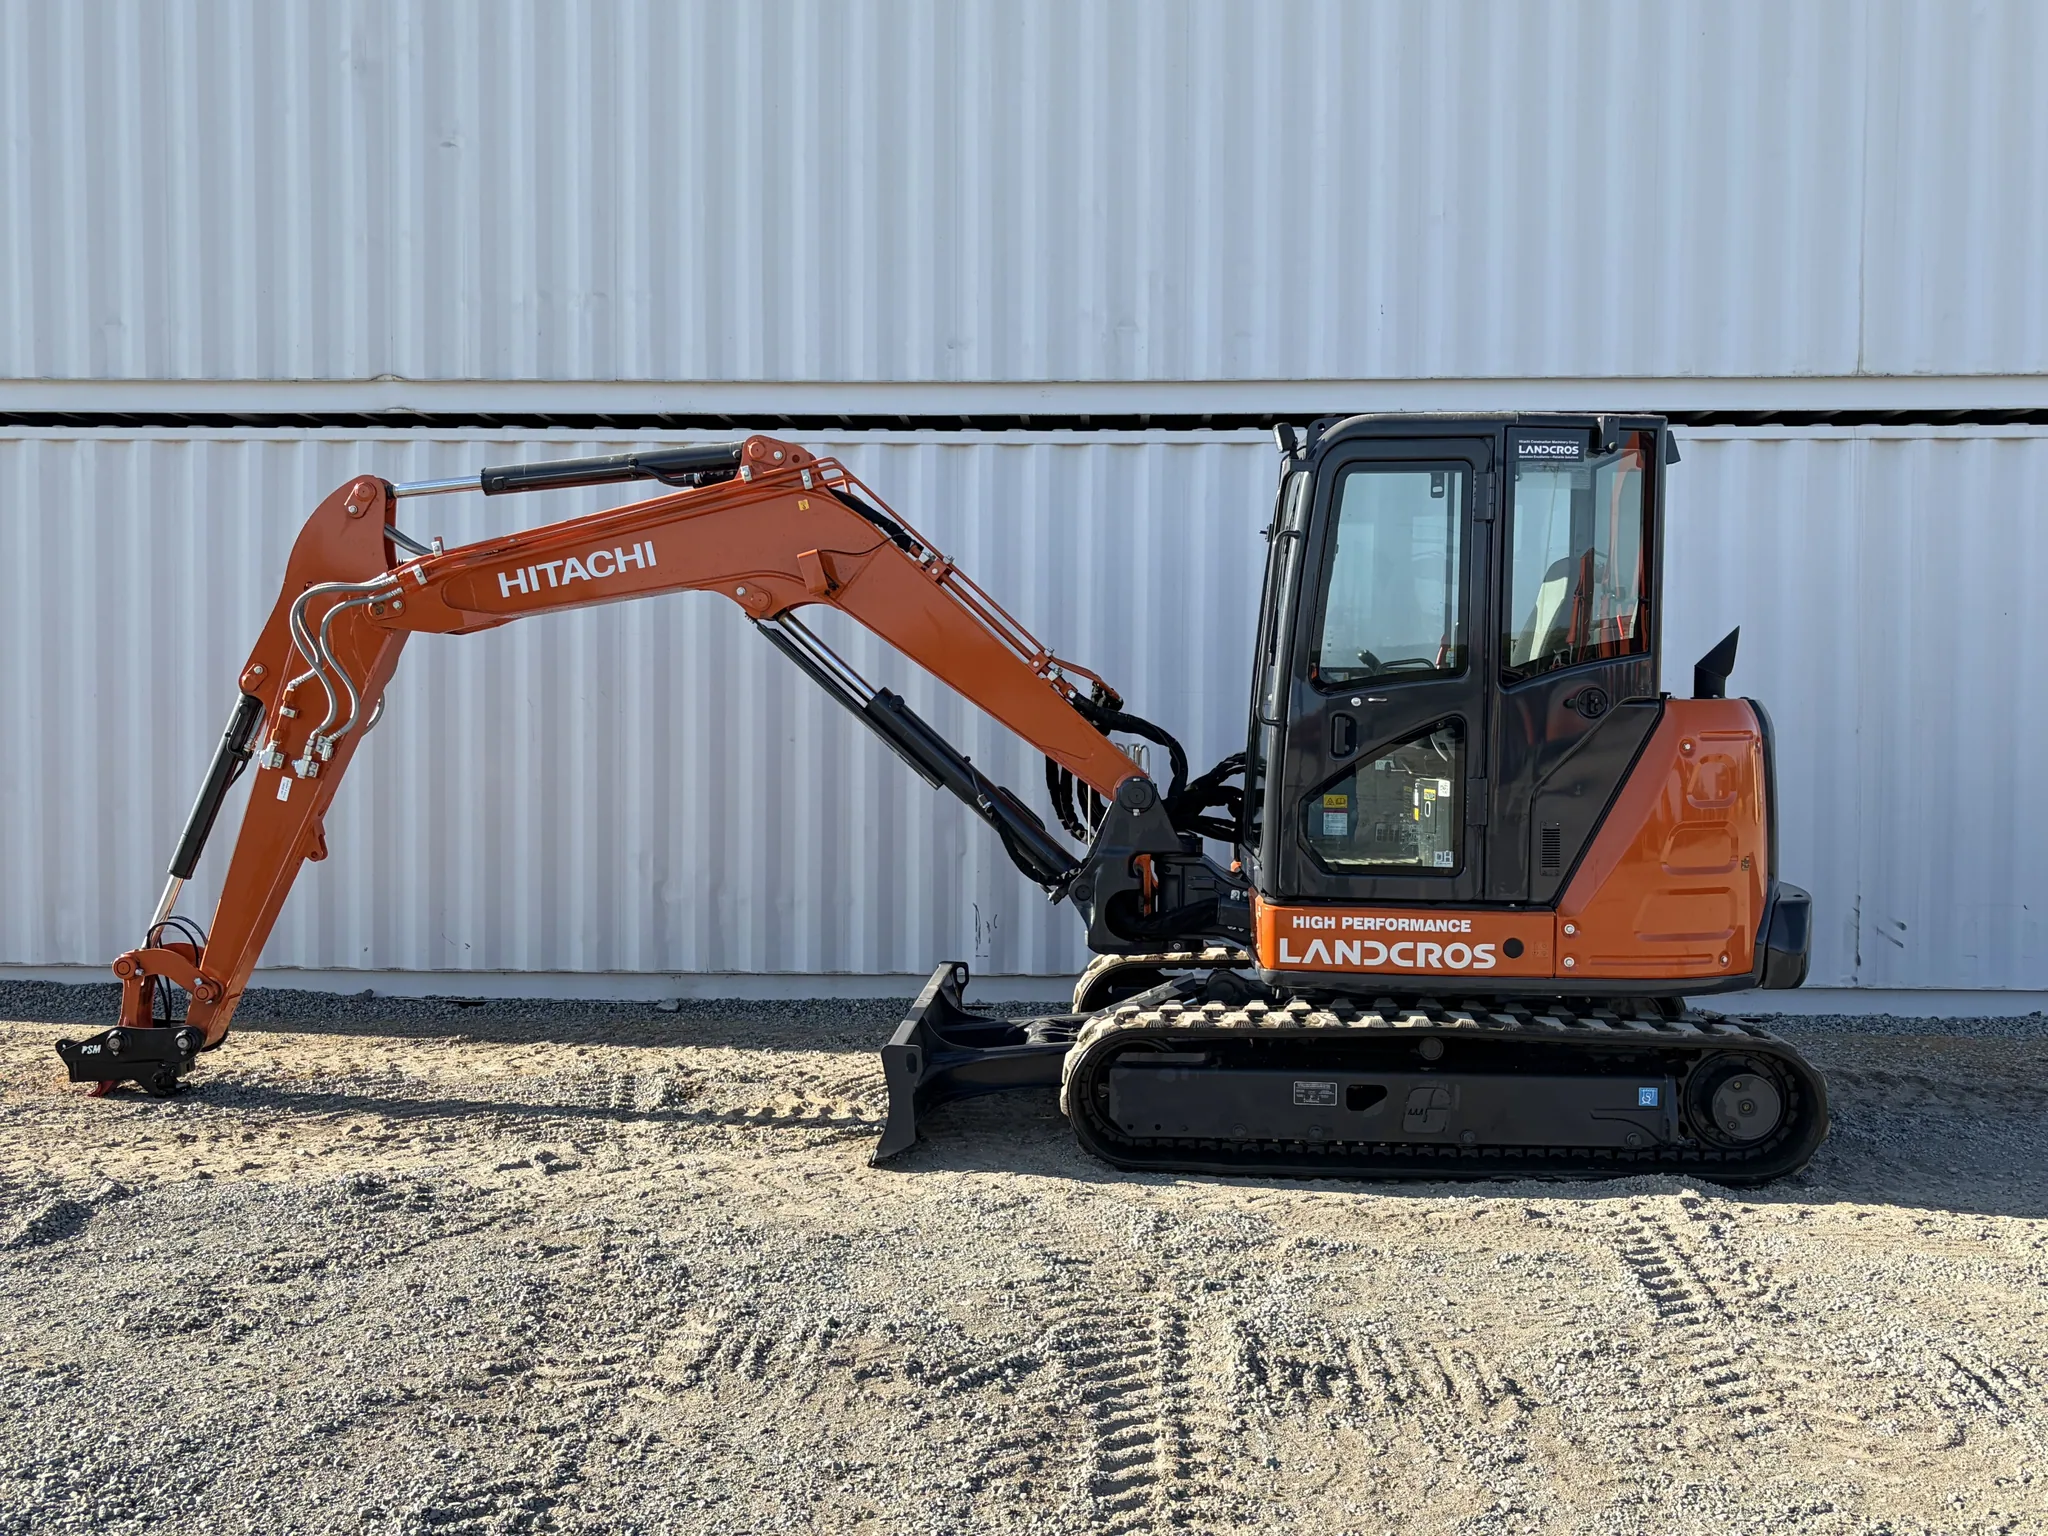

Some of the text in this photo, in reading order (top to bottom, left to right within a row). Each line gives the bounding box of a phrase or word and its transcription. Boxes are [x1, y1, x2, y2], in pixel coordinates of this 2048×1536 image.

[1518, 445, 1579, 454] LANDCROS
[497, 540, 657, 598] HITACHI
[1292, 916, 1472, 933] HIGH PERFORMANCE
[1279, 938, 1497, 969] LANDCROS
[81, 1044, 101, 1054] PSM
